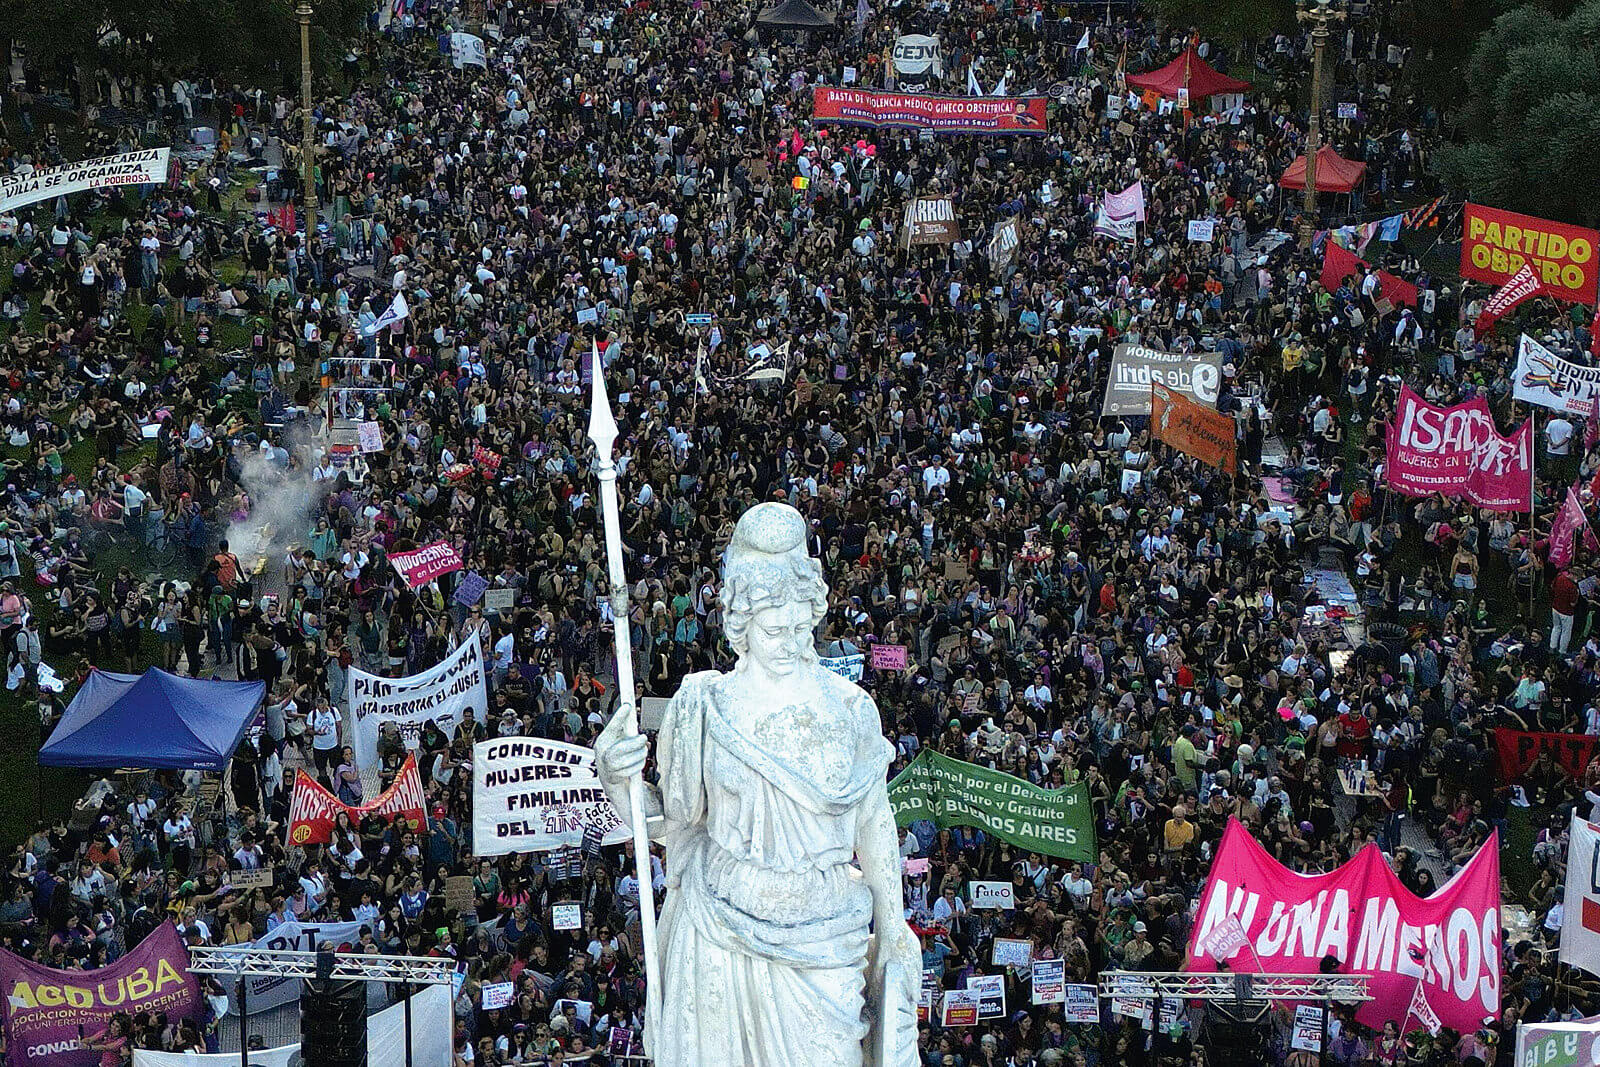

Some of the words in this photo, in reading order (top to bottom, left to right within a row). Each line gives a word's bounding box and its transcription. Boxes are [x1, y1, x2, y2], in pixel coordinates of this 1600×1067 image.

[865, 96, 902, 108] VIOLENCIA
[904, 97, 933, 112] MÉDICO
[935, 102, 964, 113] GINECO
[1, 166, 56, 188] ESTADO
[6, 180, 39, 198] VILLA
[45, 174, 62, 188] SE
[89, 179, 100, 188] LA
[104, 174, 151, 186] PODEROSA
[1470, 216, 1592, 264] PARTIDO
[1471, 244, 1584, 290] OBRRO
[487, 743, 582, 765] COMISIÓN
[485, 765, 572, 788] MUJERES
[507, 788, 611, 811] FAMILIARE
[966, 778, 991, 790] por
[994, 783, 1007, 794] el
[1066, 794, 1078, 805] al
[1007, 799, 1066, 820] Gratuito
[496, 821, 536, 838] DEL
[1019, 822, 1078, 845] AIRES
[1255, 888, 1350, 964] UNA
[1353, 896, 1499, 1013] MENOS
[97, 958, 184, 1007] UBA
[12, 1008, 77, 1033] SOCIACION
[135, 988, 190, 1014] DOCENTE
[34, 1017, 101, 1032] UNIERSIDAD
